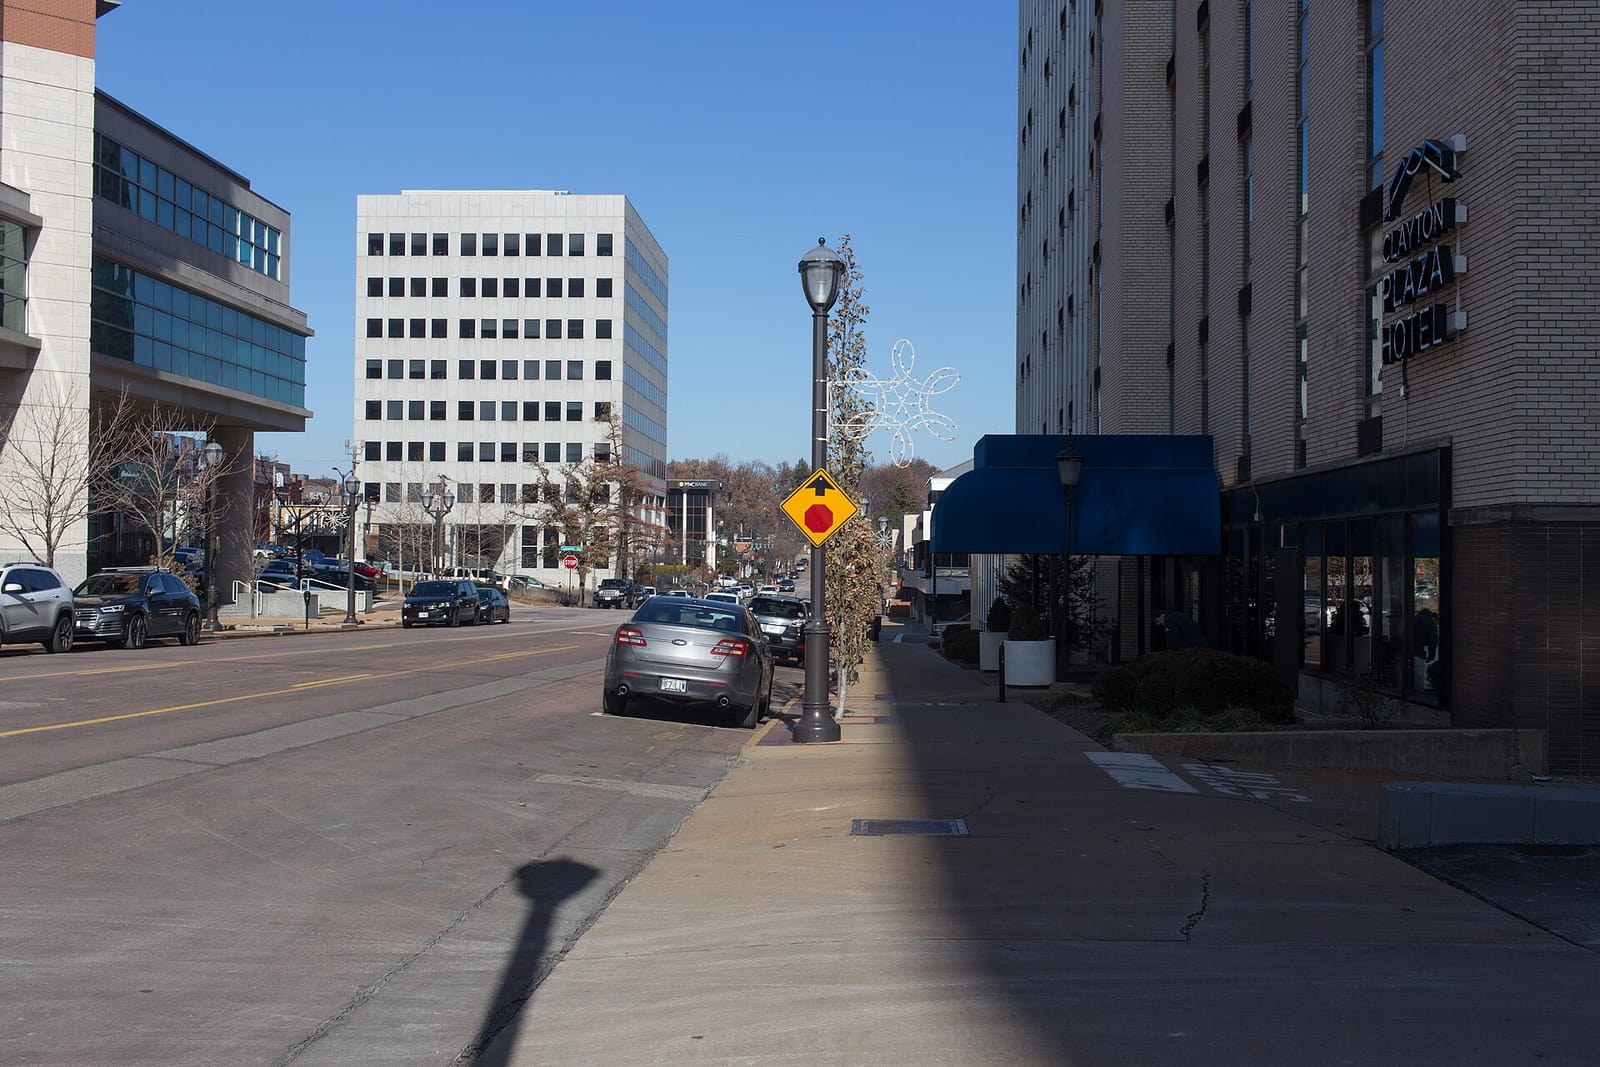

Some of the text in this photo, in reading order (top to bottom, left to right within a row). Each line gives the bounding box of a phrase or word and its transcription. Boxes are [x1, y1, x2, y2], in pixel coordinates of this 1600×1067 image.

[1382, 203, 1445, 263] CLAYTON
[1382, 244, 1444, 312] PLAZA
[1381, 304, 1443, 363] HOTEL
